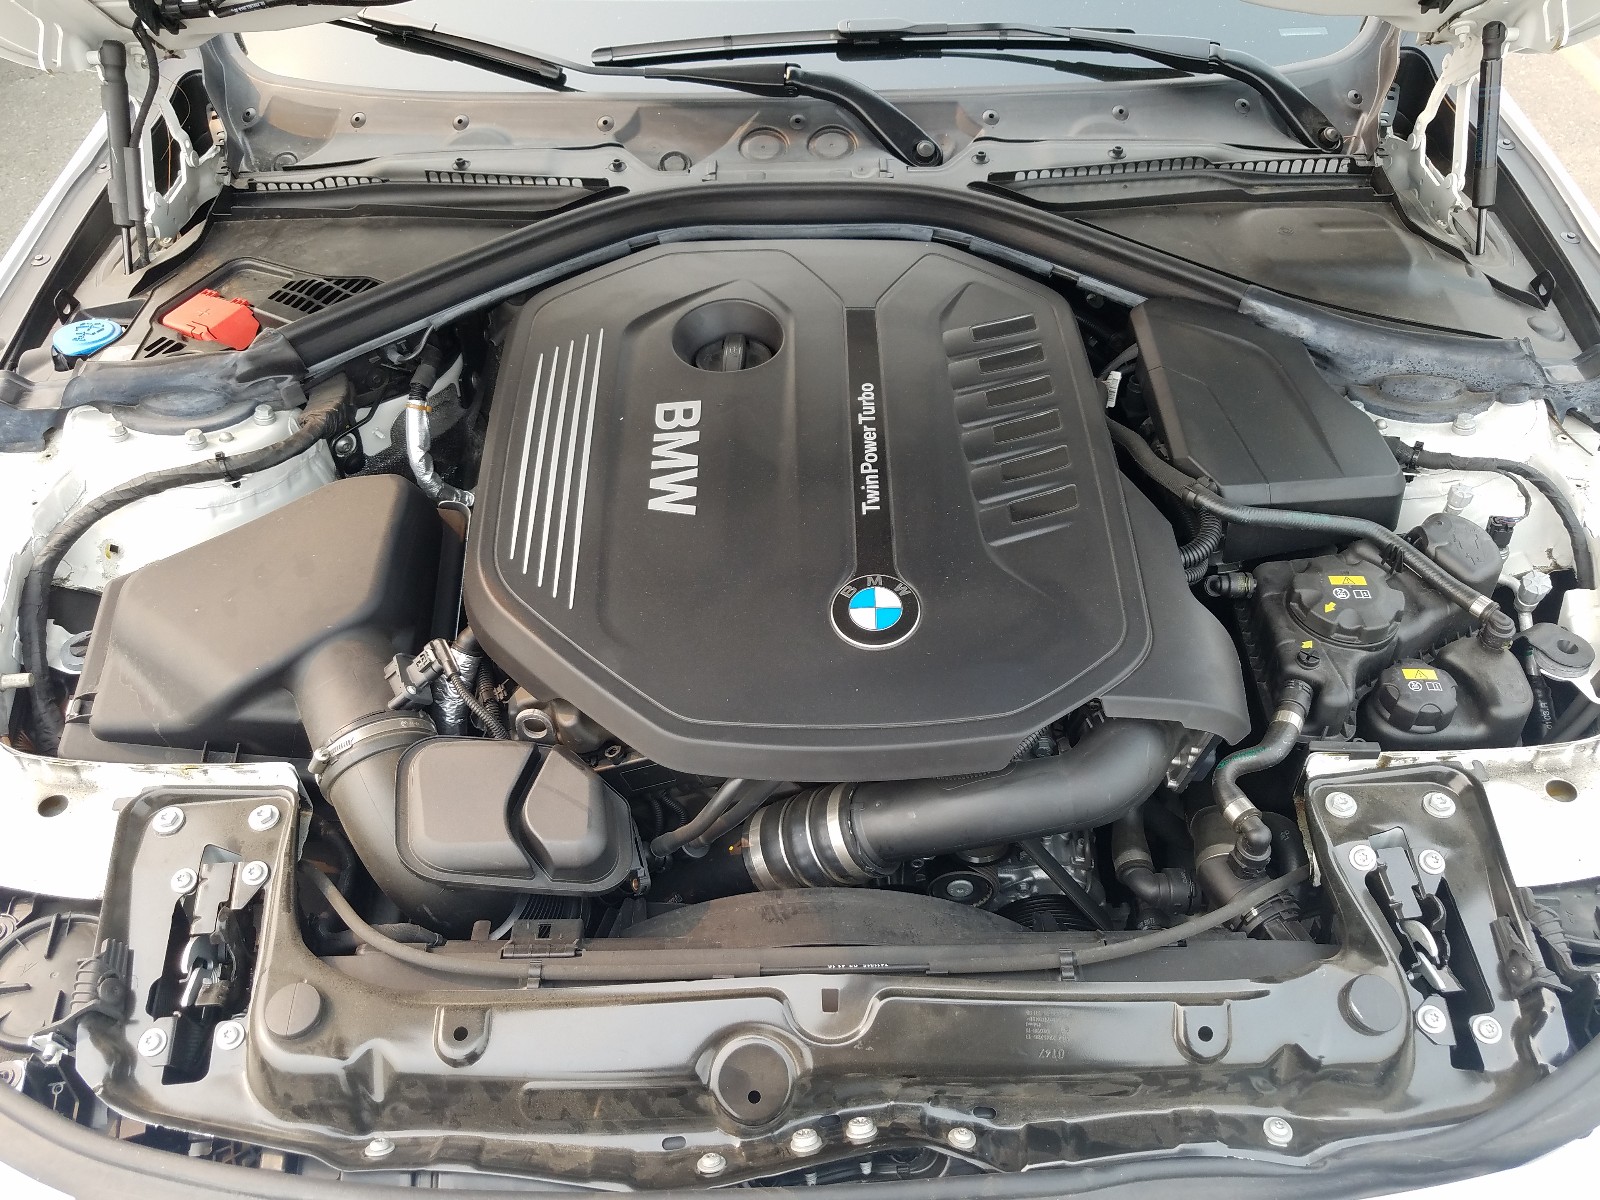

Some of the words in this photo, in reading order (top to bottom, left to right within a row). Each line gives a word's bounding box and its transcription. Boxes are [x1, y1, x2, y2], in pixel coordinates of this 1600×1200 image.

[857, 382, 876, 425] Turbo
[647, 400, 701, 515] BMW
[860, 425, 881, 515] TwinPower
[841, 574, 912, 599] BMW
